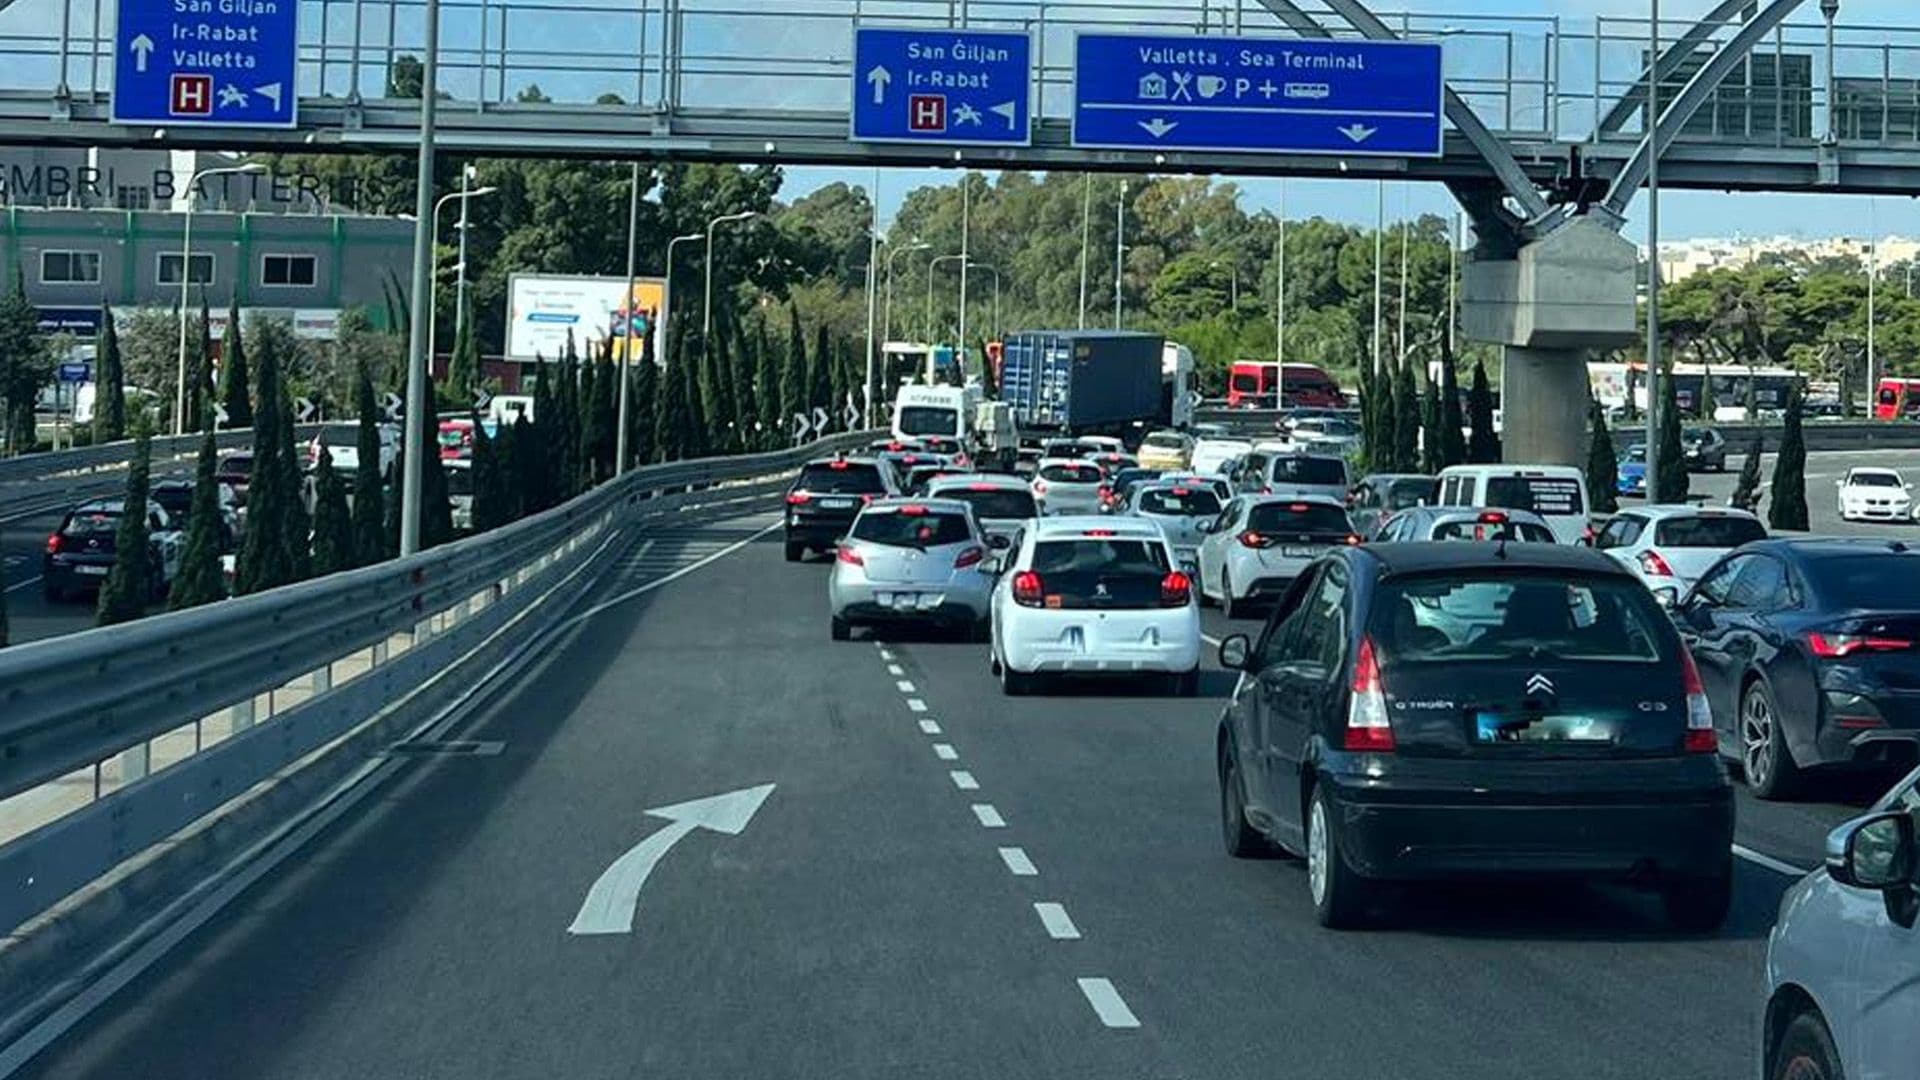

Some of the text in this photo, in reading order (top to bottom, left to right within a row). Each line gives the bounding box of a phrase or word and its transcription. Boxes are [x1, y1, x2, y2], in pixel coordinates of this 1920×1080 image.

[174, 0, 212, 13] San
[172, 23, 259, 42] Ir-Rabat
[172, 50, 256, 68] Valletta
[908, 39, 1009, 63] San Ġiljan
[1139, 47, 1217, 65] Valletta
[1240, 49, 1275, 67] Sea
[1283, 51, 1364, 70] Terminal
[908, 70, 990, 88] Ir-Rabat
[1235, 78, 1250, 99] P
[180, 81, 203, 109] H
[917, 101, 937, 126] H
